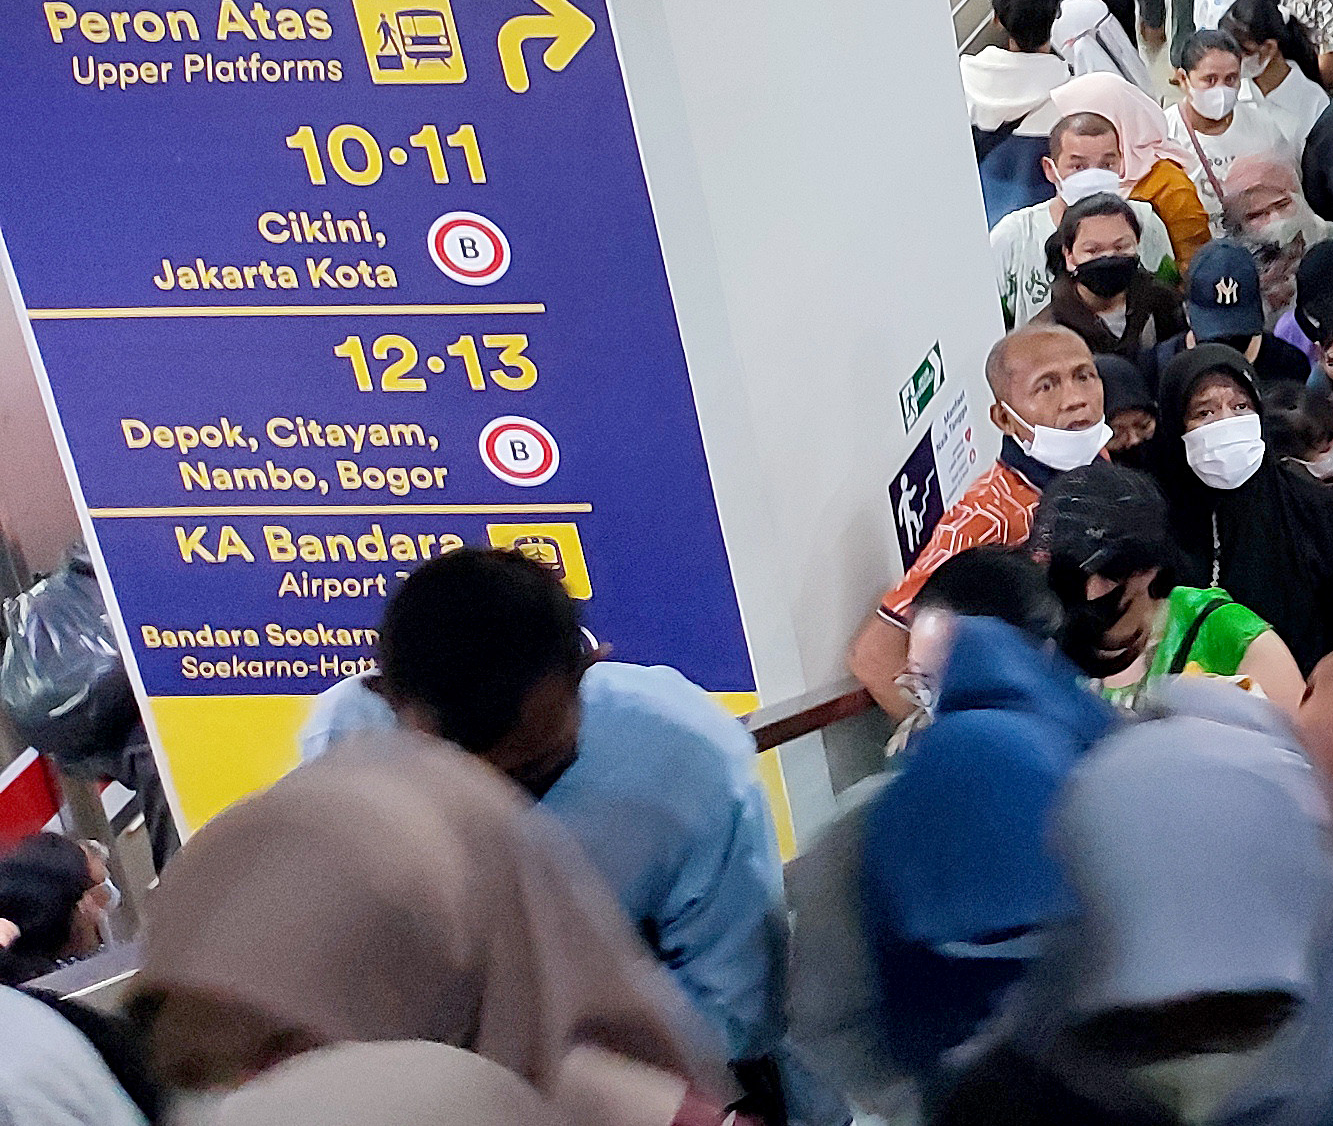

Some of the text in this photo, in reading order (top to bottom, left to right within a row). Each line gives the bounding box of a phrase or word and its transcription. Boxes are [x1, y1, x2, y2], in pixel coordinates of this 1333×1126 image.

[43, 1, 200, 44] Peron
[72, 52, 343, 91] Upper Platforms
[257, 210, 386, 249] Cikini,
[458, 238, 480, 259] B
[153, 257, 398, 291] Jakarta Kota
[120, 416, 439, 455] Depok, Citayam,
[509, 441, 530, 461] B
[178, 460, 448, 496] Nambo, Bogor
[174, 525, 255, 564] KA
[278, 572, 387, 603] Airport
[140, 623, 380, 649] Bandara Soekarn
[181, 654, 379, 683] Soekarno-Hatt
